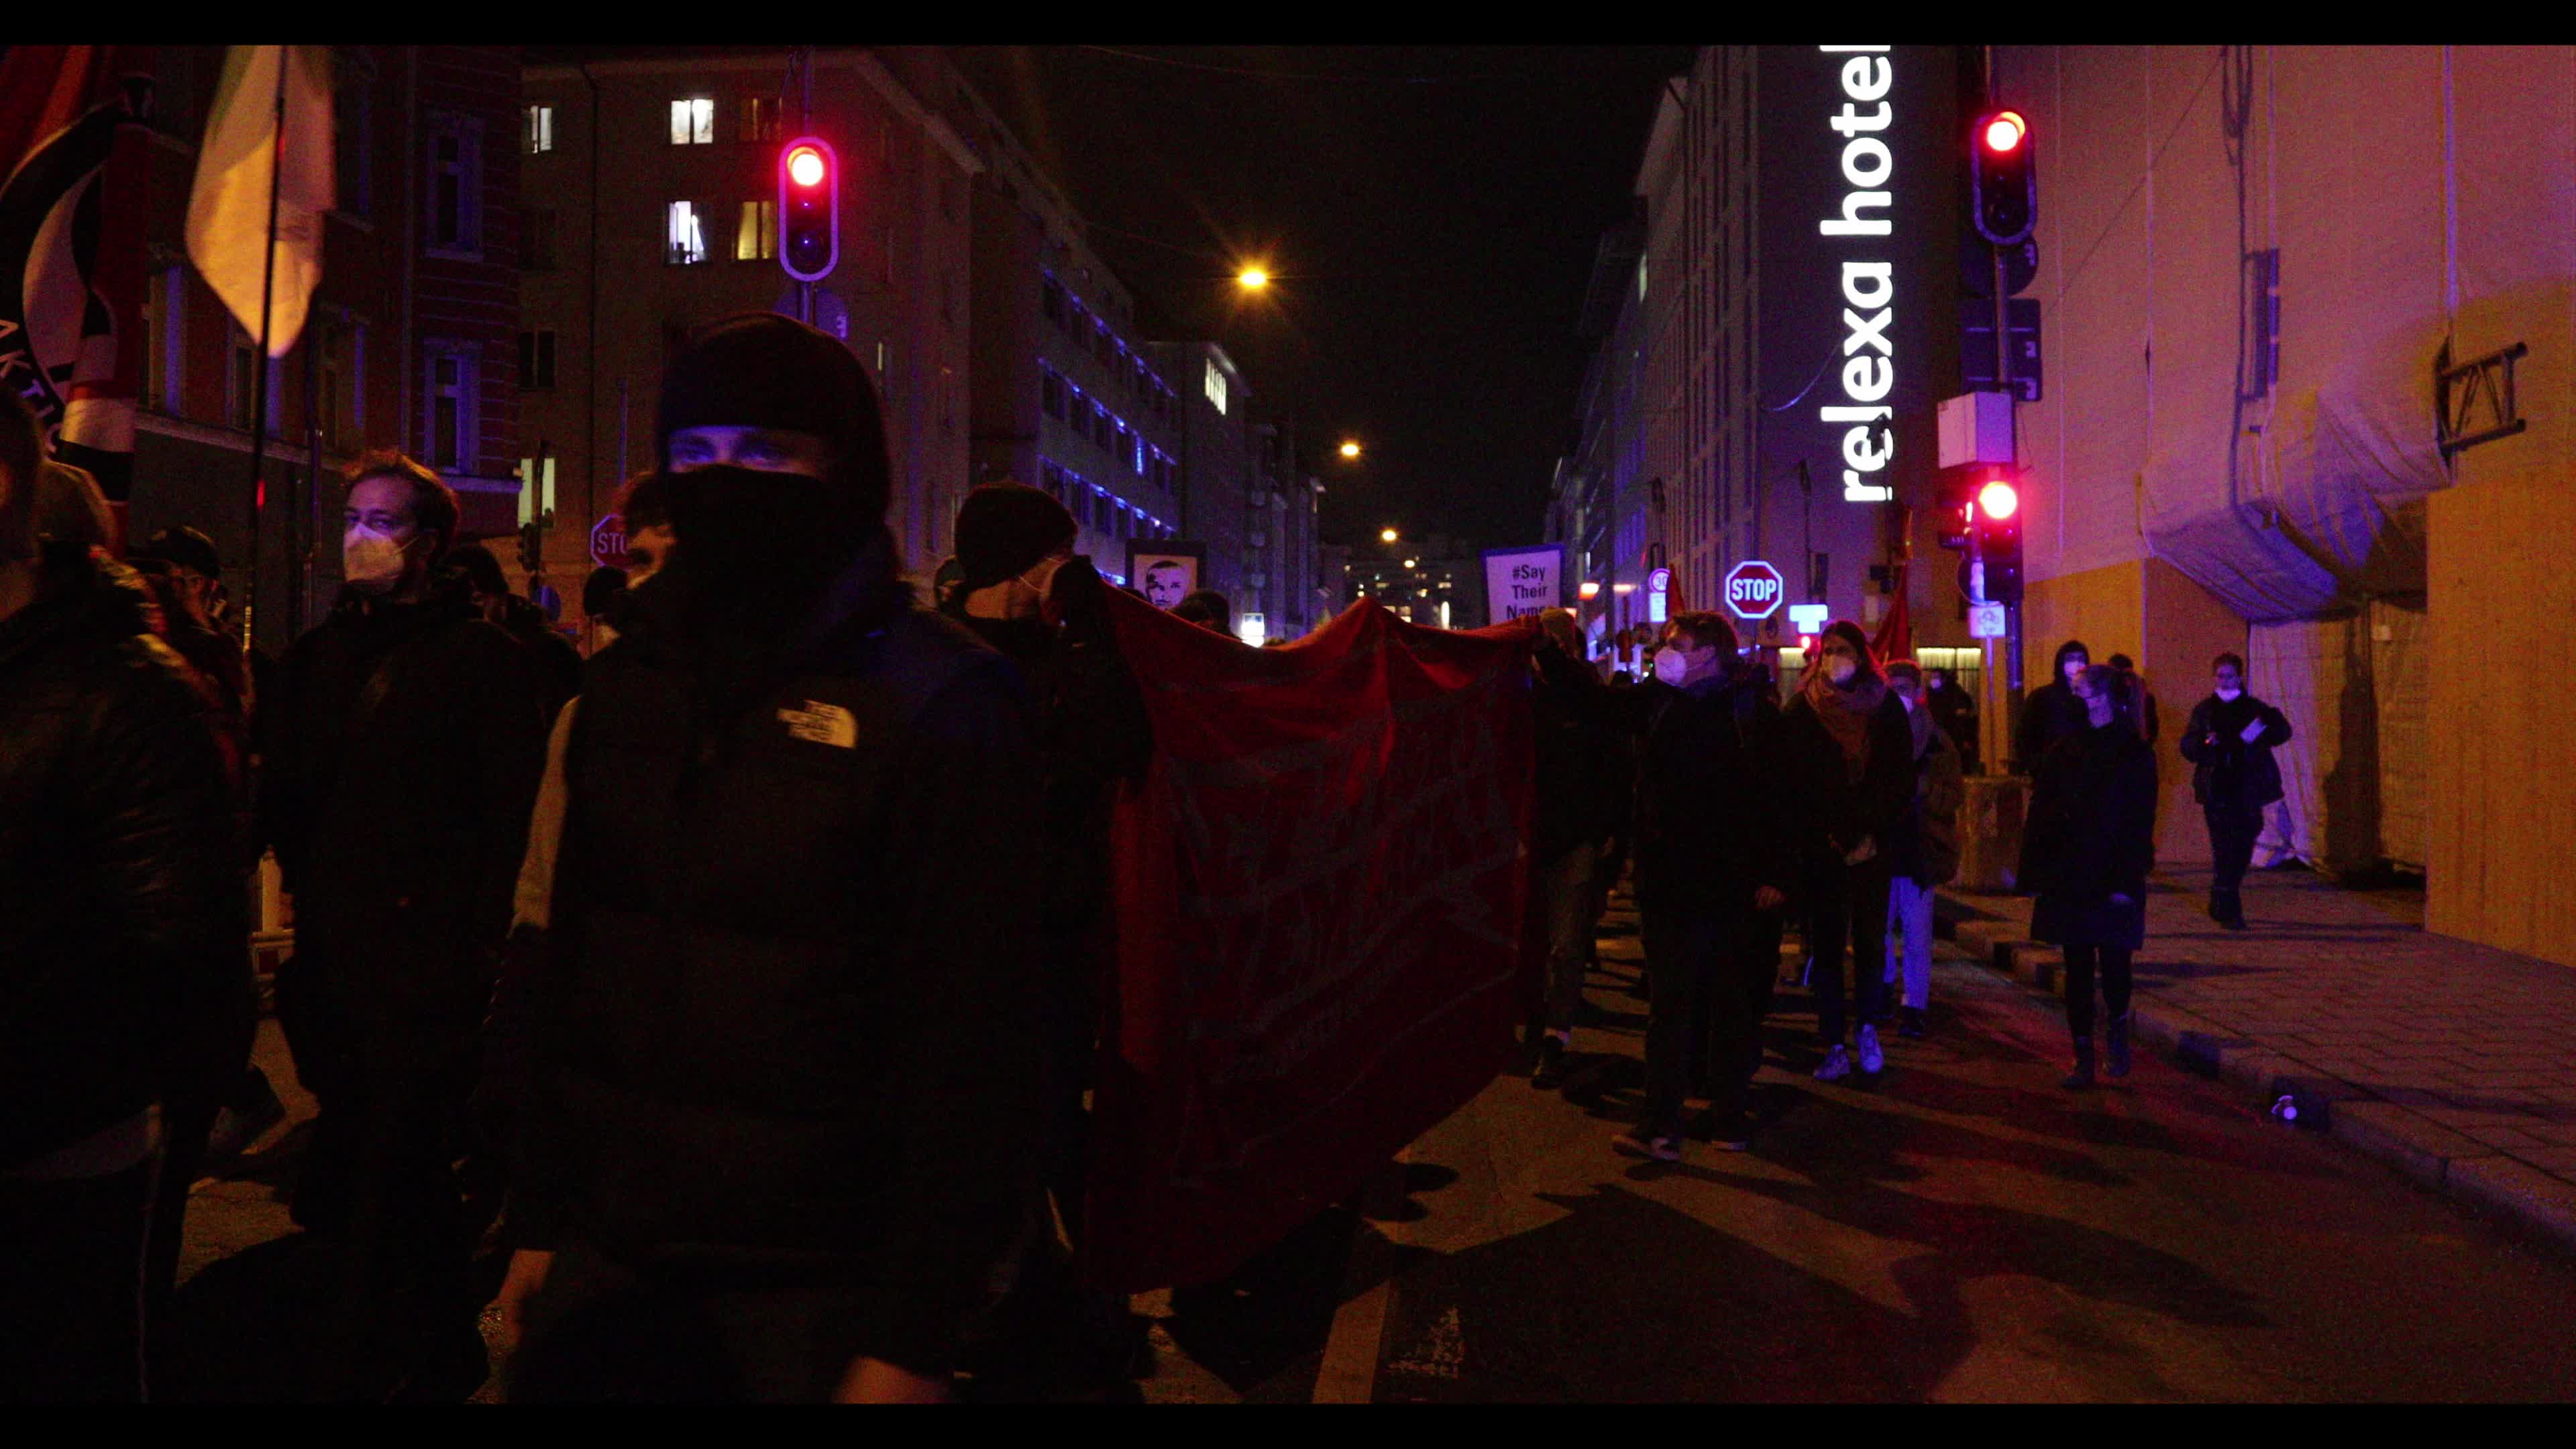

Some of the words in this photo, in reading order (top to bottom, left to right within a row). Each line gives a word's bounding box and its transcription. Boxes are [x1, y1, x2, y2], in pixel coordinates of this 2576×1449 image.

[1821, 262, 1893, 502] relexa
[596, 531, 629, 556] STO
[1513, 564, 1546, 581] #Say
[1511, 582, 1547, 599] Their
[1731, 578, 1776, 601] STOP
